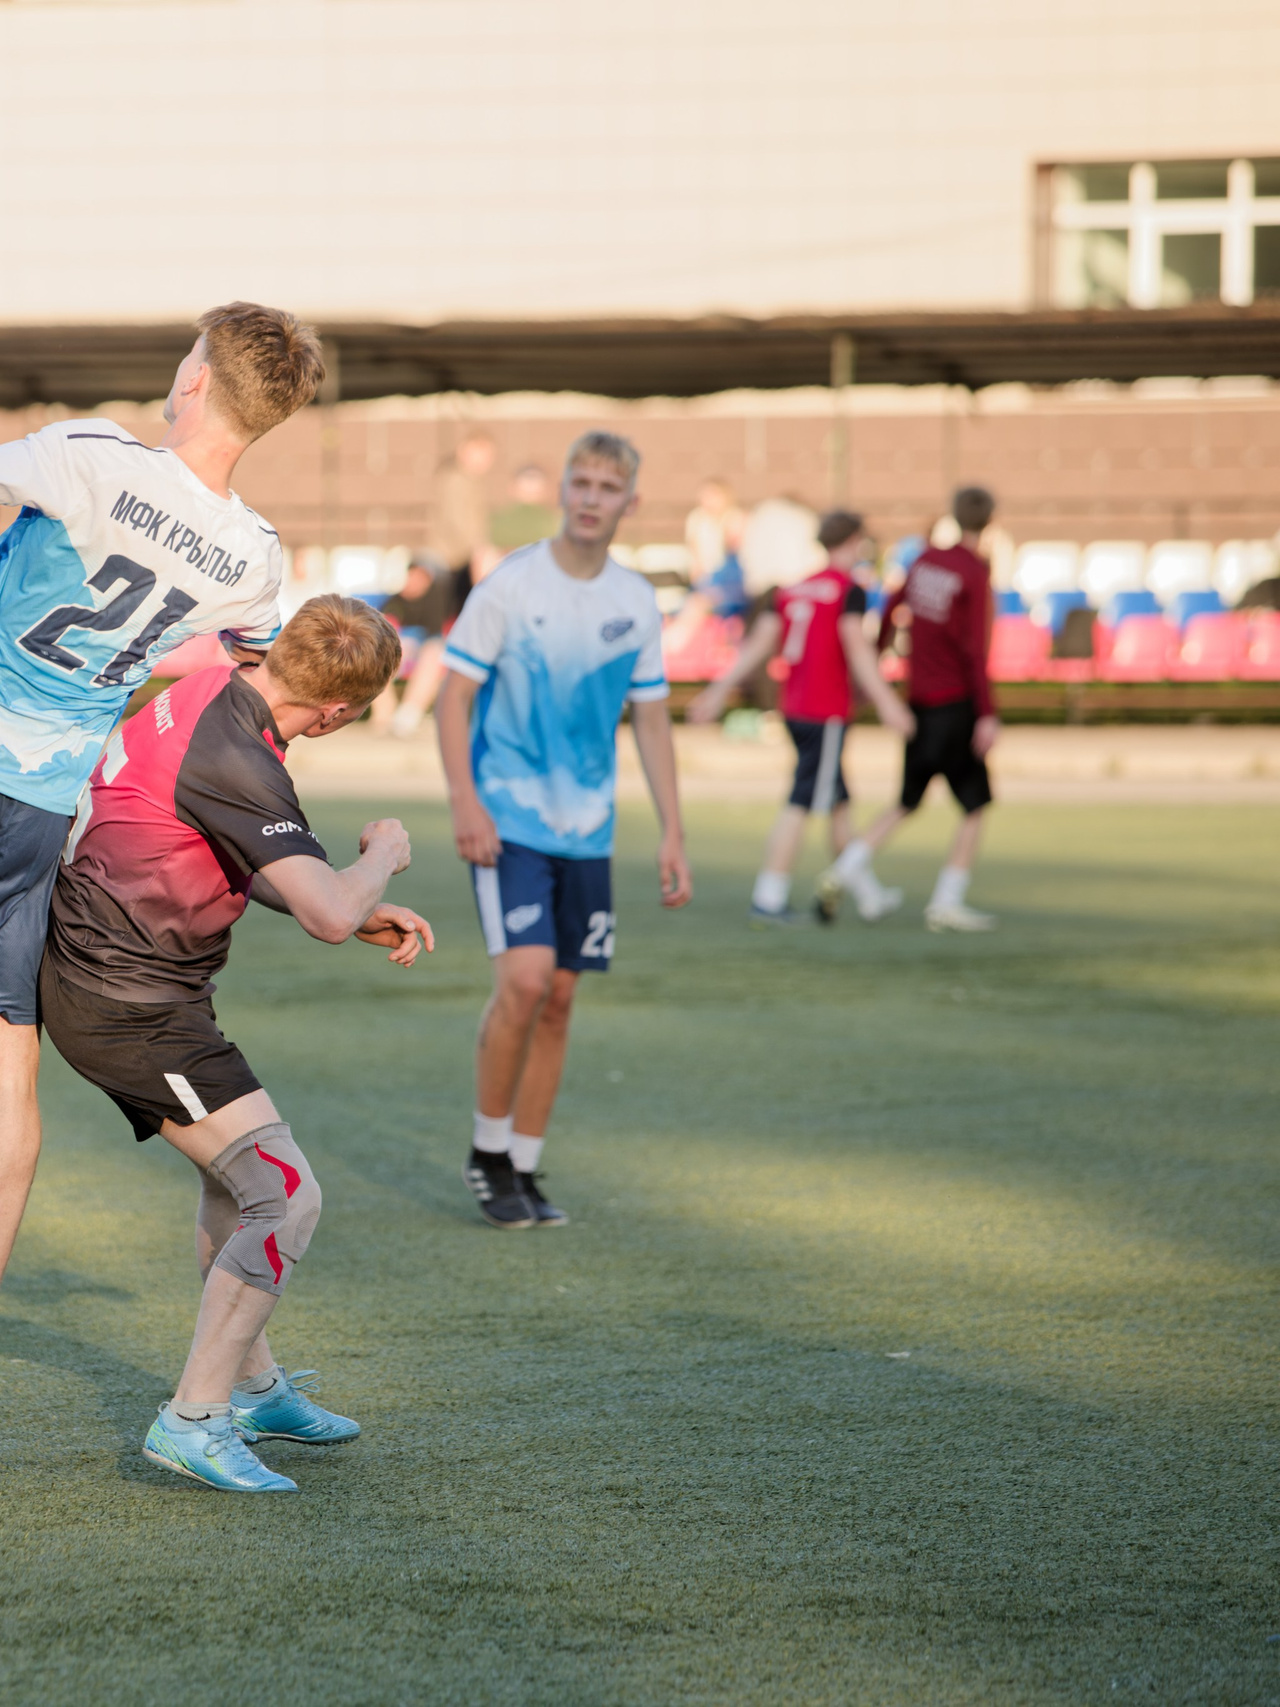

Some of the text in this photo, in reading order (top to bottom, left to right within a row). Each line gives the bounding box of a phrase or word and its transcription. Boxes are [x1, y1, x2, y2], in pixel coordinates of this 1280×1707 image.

[109, 489, 248, 588] МФК КРЫЛЬЯ
[16, 553, 200, 689] 21
